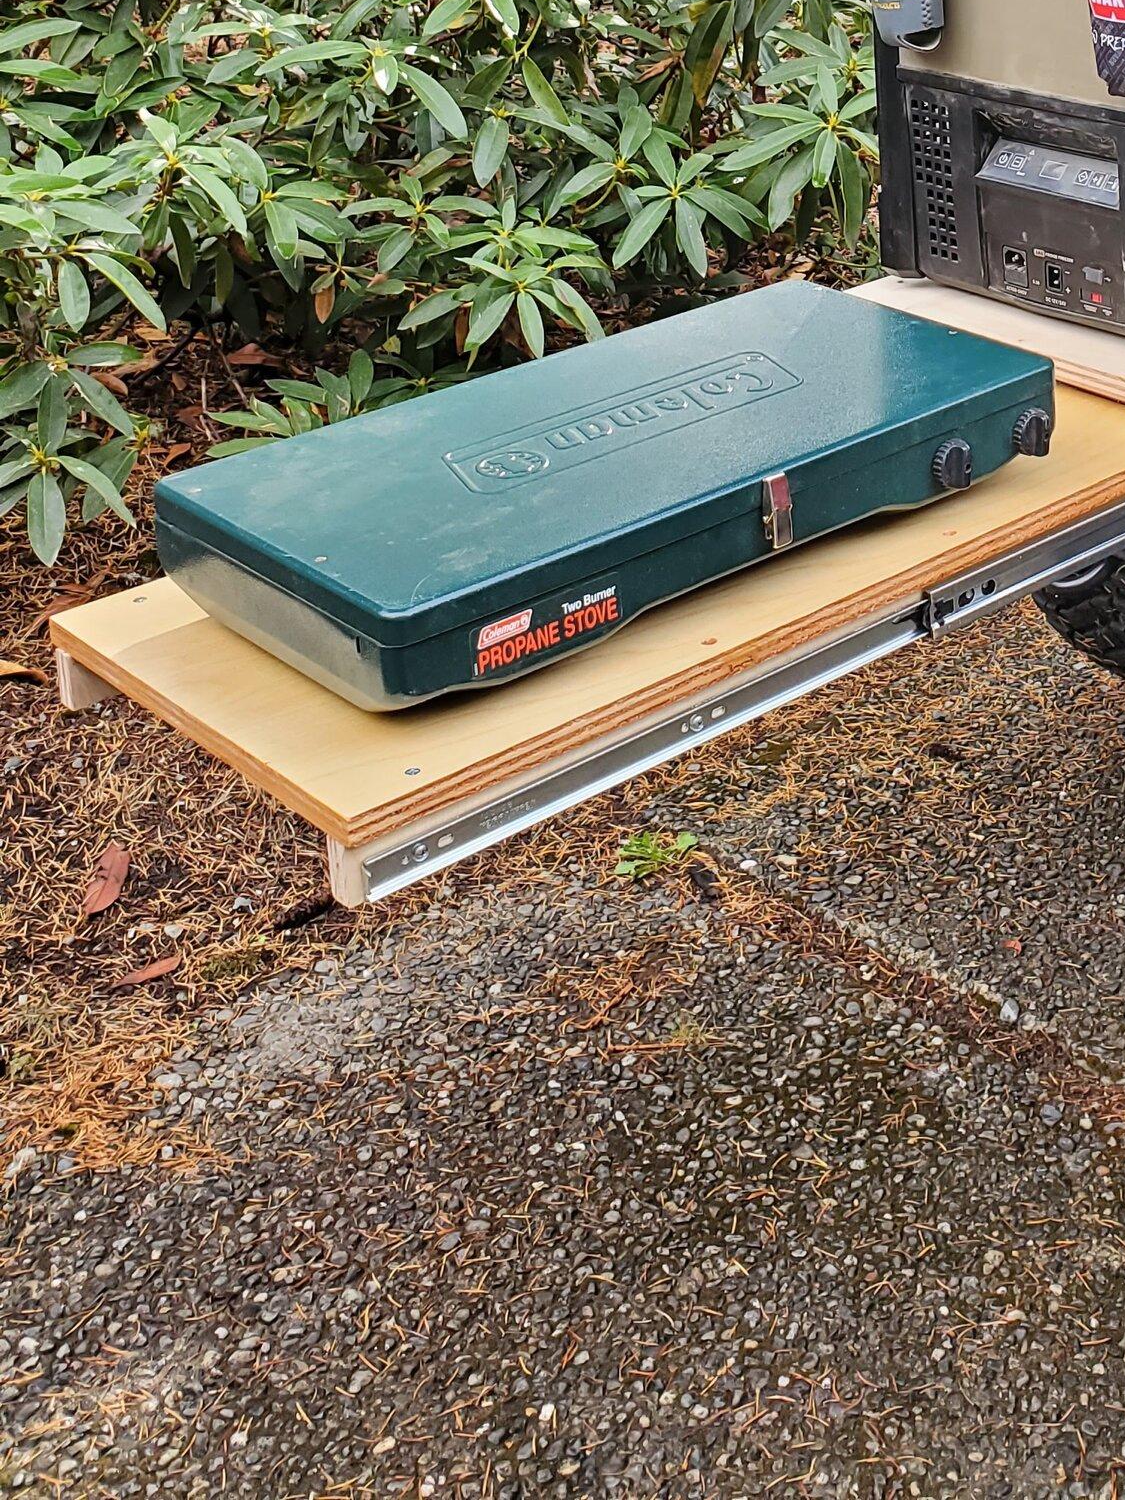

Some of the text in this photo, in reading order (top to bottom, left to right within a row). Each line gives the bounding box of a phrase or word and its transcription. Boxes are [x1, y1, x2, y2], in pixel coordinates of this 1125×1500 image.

[545, 372, 773, 450] Coleman
[561, 585, 616, 614] Two Burner
[478, 597, 619, 675] PROPANE STOVE
[483, 620, 520, 642] Coleman
